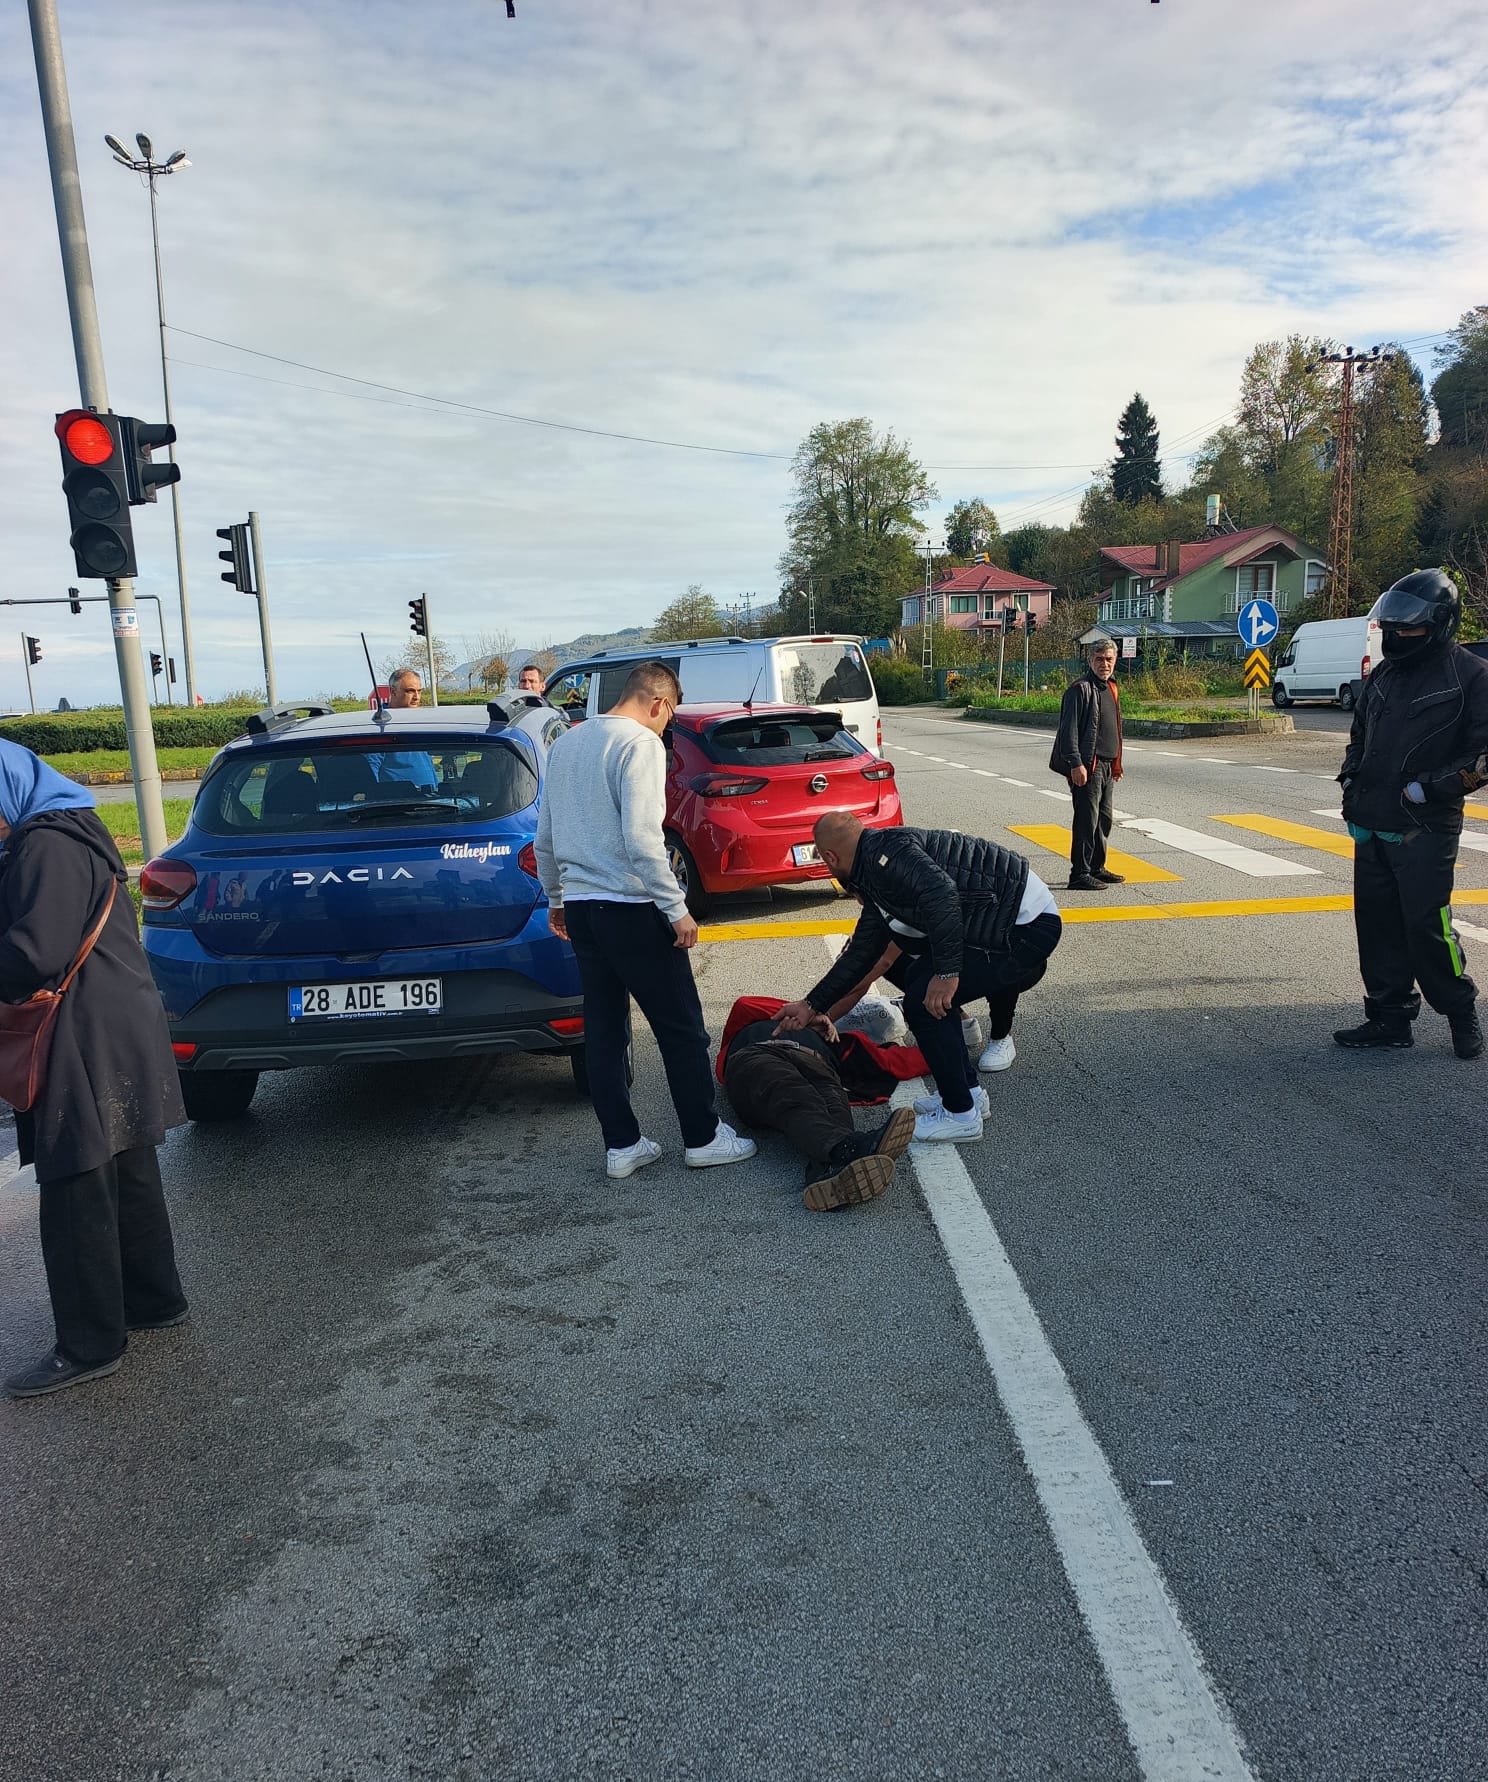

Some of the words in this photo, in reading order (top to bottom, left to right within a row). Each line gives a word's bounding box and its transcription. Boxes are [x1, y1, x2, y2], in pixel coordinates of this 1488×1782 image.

[440, 841, 511, 864] Küheylan
[292, 867, 415, 885] DACIA
[198, 912, 259, 921] SANDERO
[303, 988, 330, 1013] 28
[344, 984, 386, 1011] ADE
[400, 982, 438, 1007] 196
[291, 1003, 302, 1011] TR
